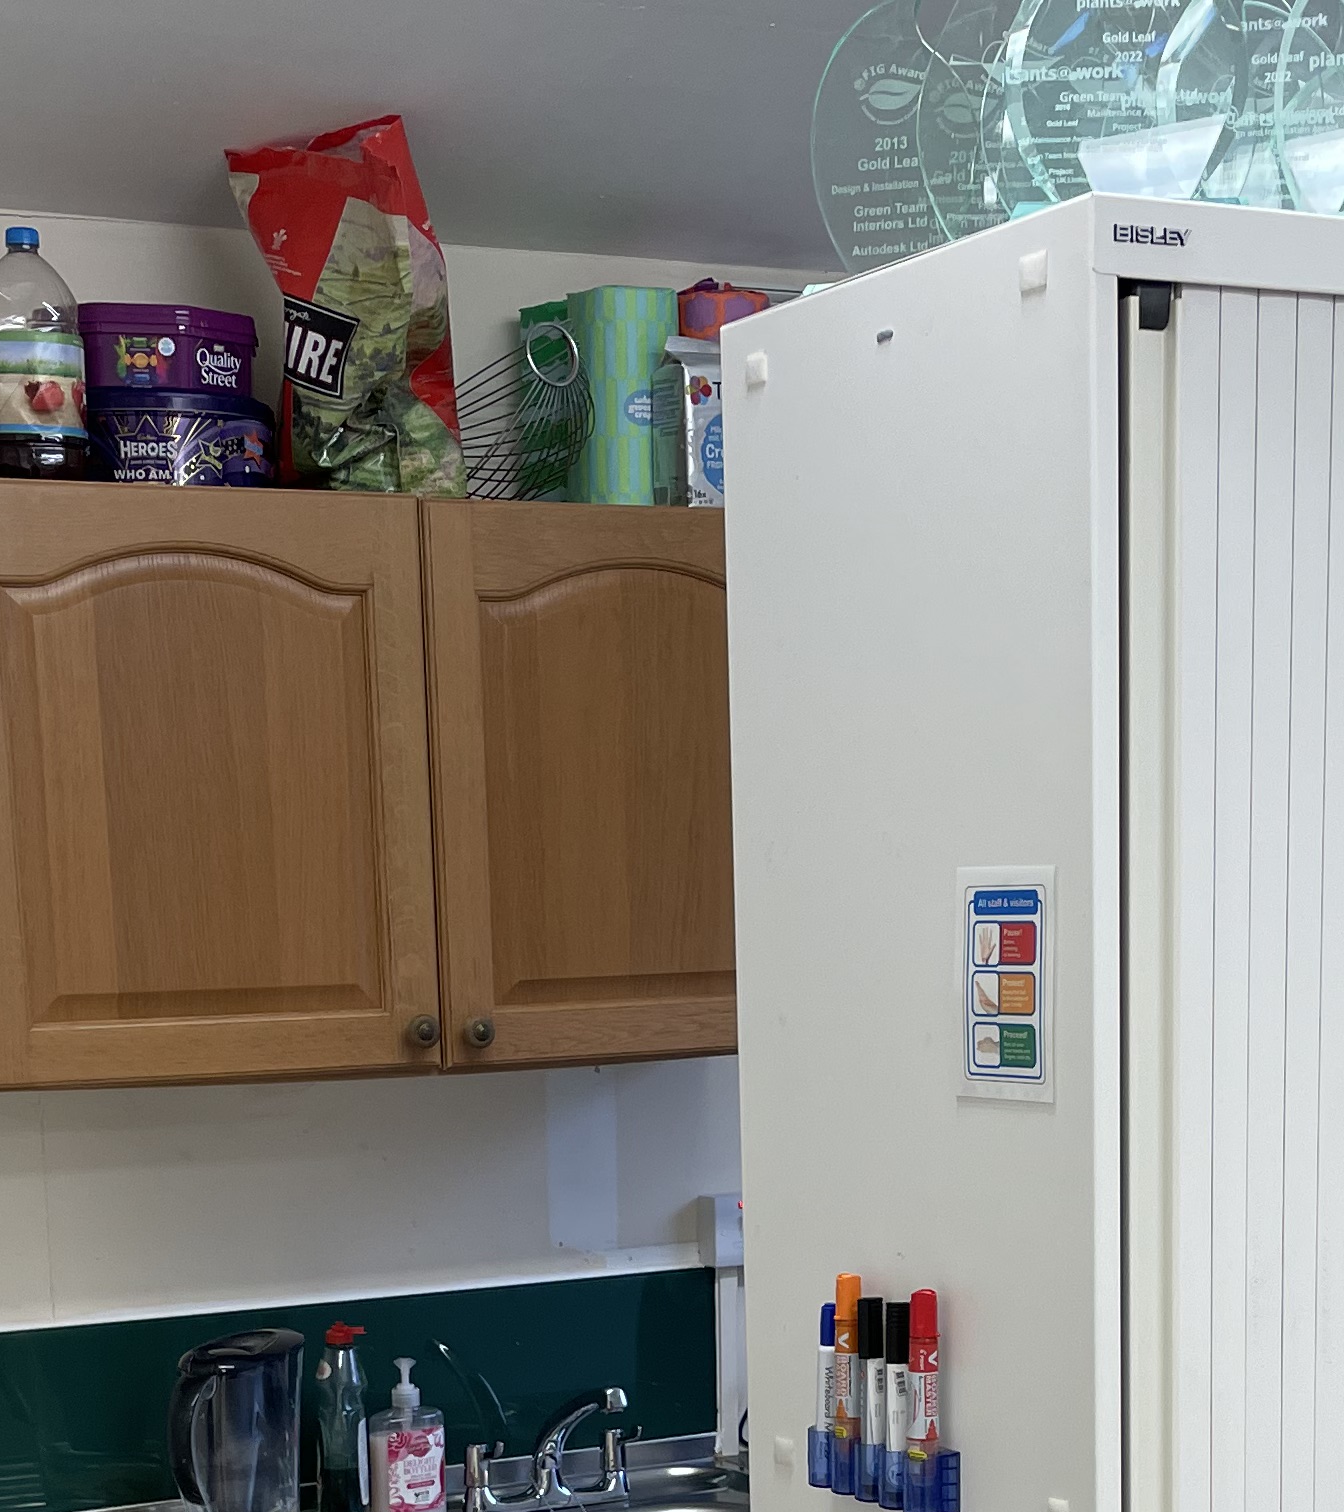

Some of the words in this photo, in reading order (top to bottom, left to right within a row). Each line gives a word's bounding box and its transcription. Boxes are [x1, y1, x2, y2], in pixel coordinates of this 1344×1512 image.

[1102, 31, 1129, 43] Gold
[1132, 29, 1156, 42] Leaf
[1115, 51, 1143, 62] 2022
[1251, 52, 1278, 65] Gold
[1060, 91, 1094, 103] Green
[874, 135, 908, 151] 2013
[858, 156, 890, 171] Gold
[894, 155, 920, 170] Lea
[831, 184, 861, 196] Design
[863, 182, 870, 193] &
[872, 179, 919, 193] Installation
[854, 203, 891, 217] Green
[895, 202, 928, 215] Team
[853, 218, 905, 232] Interiors
[908, 215, 929, 229] Ltd
[1113, 223, 1193, 247] BISLEY
[852, 242, 906, 257] Autodesk
[910, 240, 930, 252] Ltd
[285, 321, 344, 384] IRE
[196, 347, 242, 375] Quality
[201, 366, 238, 389] Street
[120, 440, 179, 460] HEROES
[114, 469, 146, 481] WHO
[149, 469, 171, 481] AM
